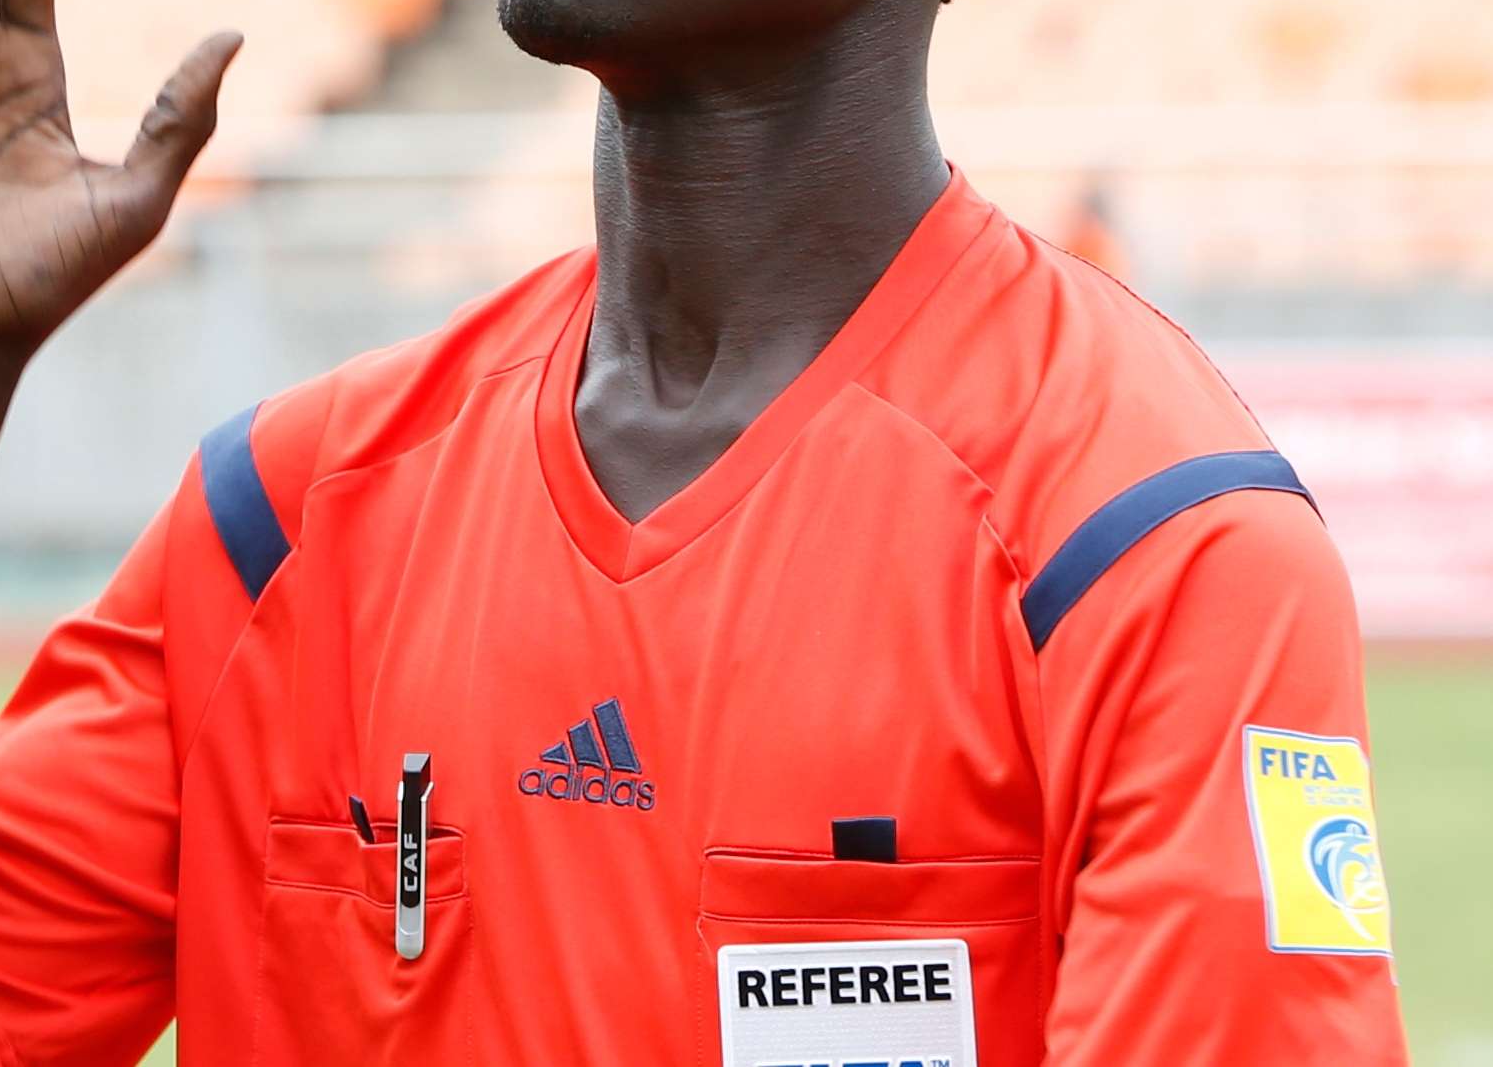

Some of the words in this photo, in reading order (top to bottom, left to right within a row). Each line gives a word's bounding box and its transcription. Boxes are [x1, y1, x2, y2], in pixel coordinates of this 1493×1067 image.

[1260, 747, 1337, 781] FIFA
[519, 764, 655, 810] adidas
[404, 833, 418, 892] CAF
[737, 963, 952, 1008] REFEREE
